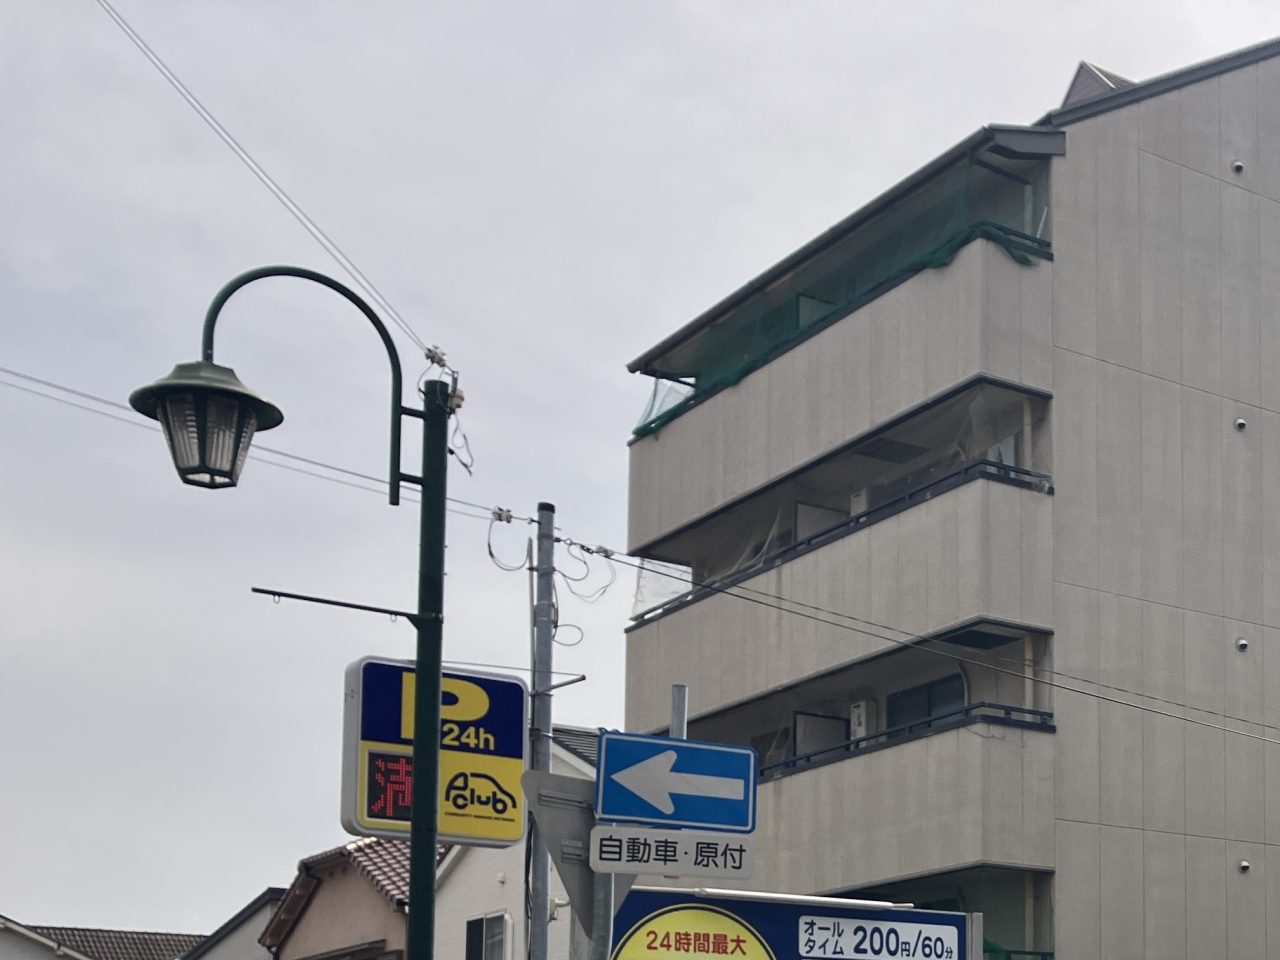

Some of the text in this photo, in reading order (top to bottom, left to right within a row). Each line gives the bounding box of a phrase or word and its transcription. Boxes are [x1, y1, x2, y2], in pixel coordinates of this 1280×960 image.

[441, 722, 495, 751] 24h
[598, 834, 747, 870] 自動車・原付
[803, 919, 845, 938] オール
[646, 930, 747, 956] 24時間最大
[804, 937, 845, 956] タイム
